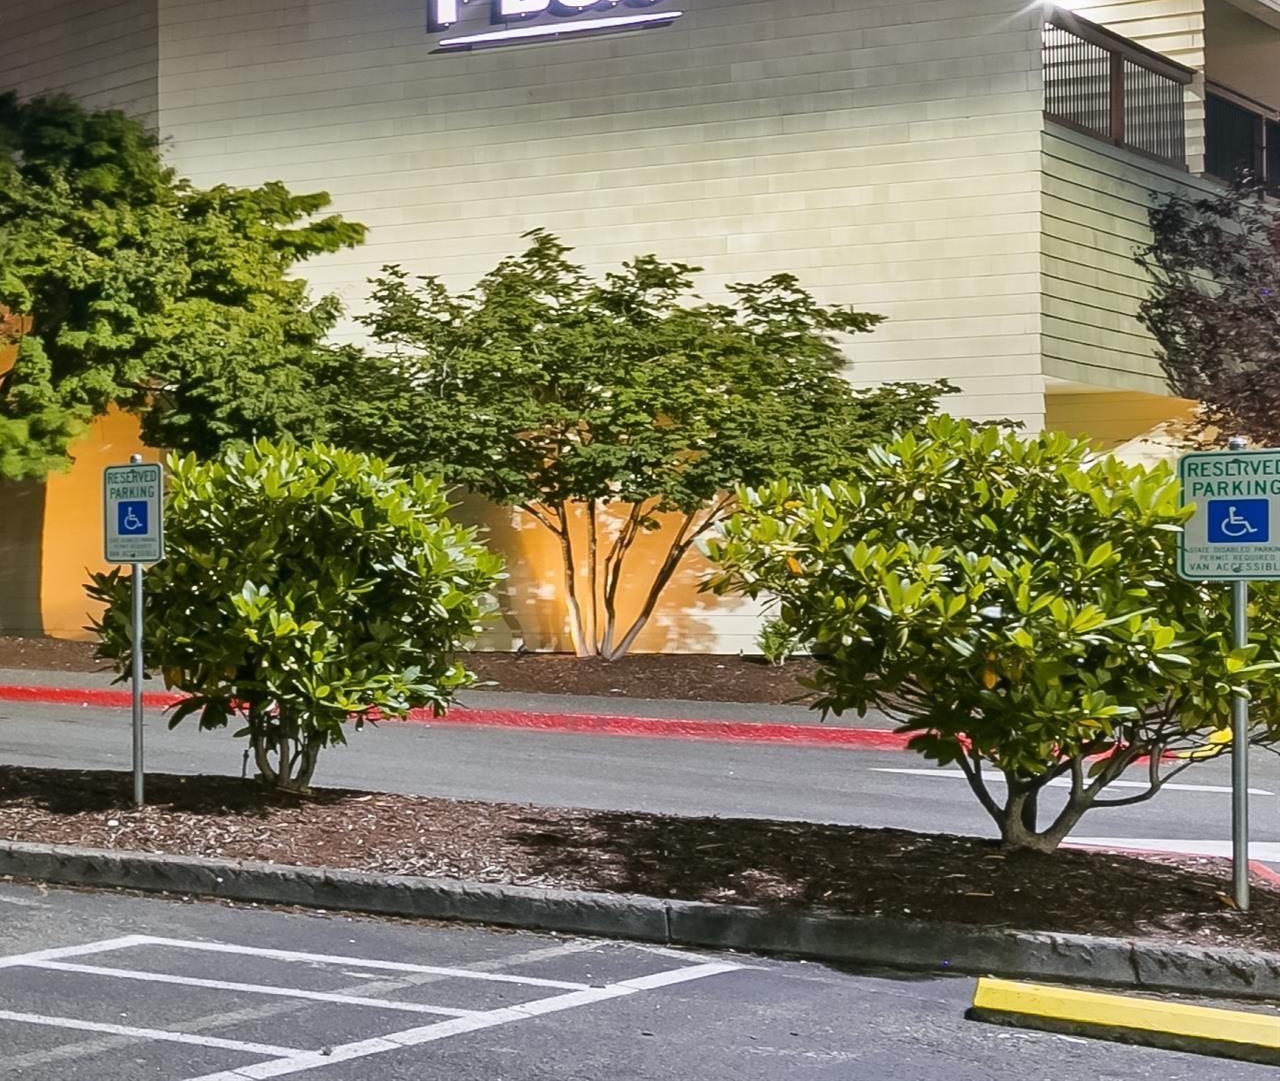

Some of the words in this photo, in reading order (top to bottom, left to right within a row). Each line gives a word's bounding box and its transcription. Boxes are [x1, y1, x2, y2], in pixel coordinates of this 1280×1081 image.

[107, 470, 156, 484] RESERVED
[110, 485, 154, 499] PARKING
[1192, 479, 1280, 497] PARKING
[1216, 562, 1280, 571] ACCESSIBL
